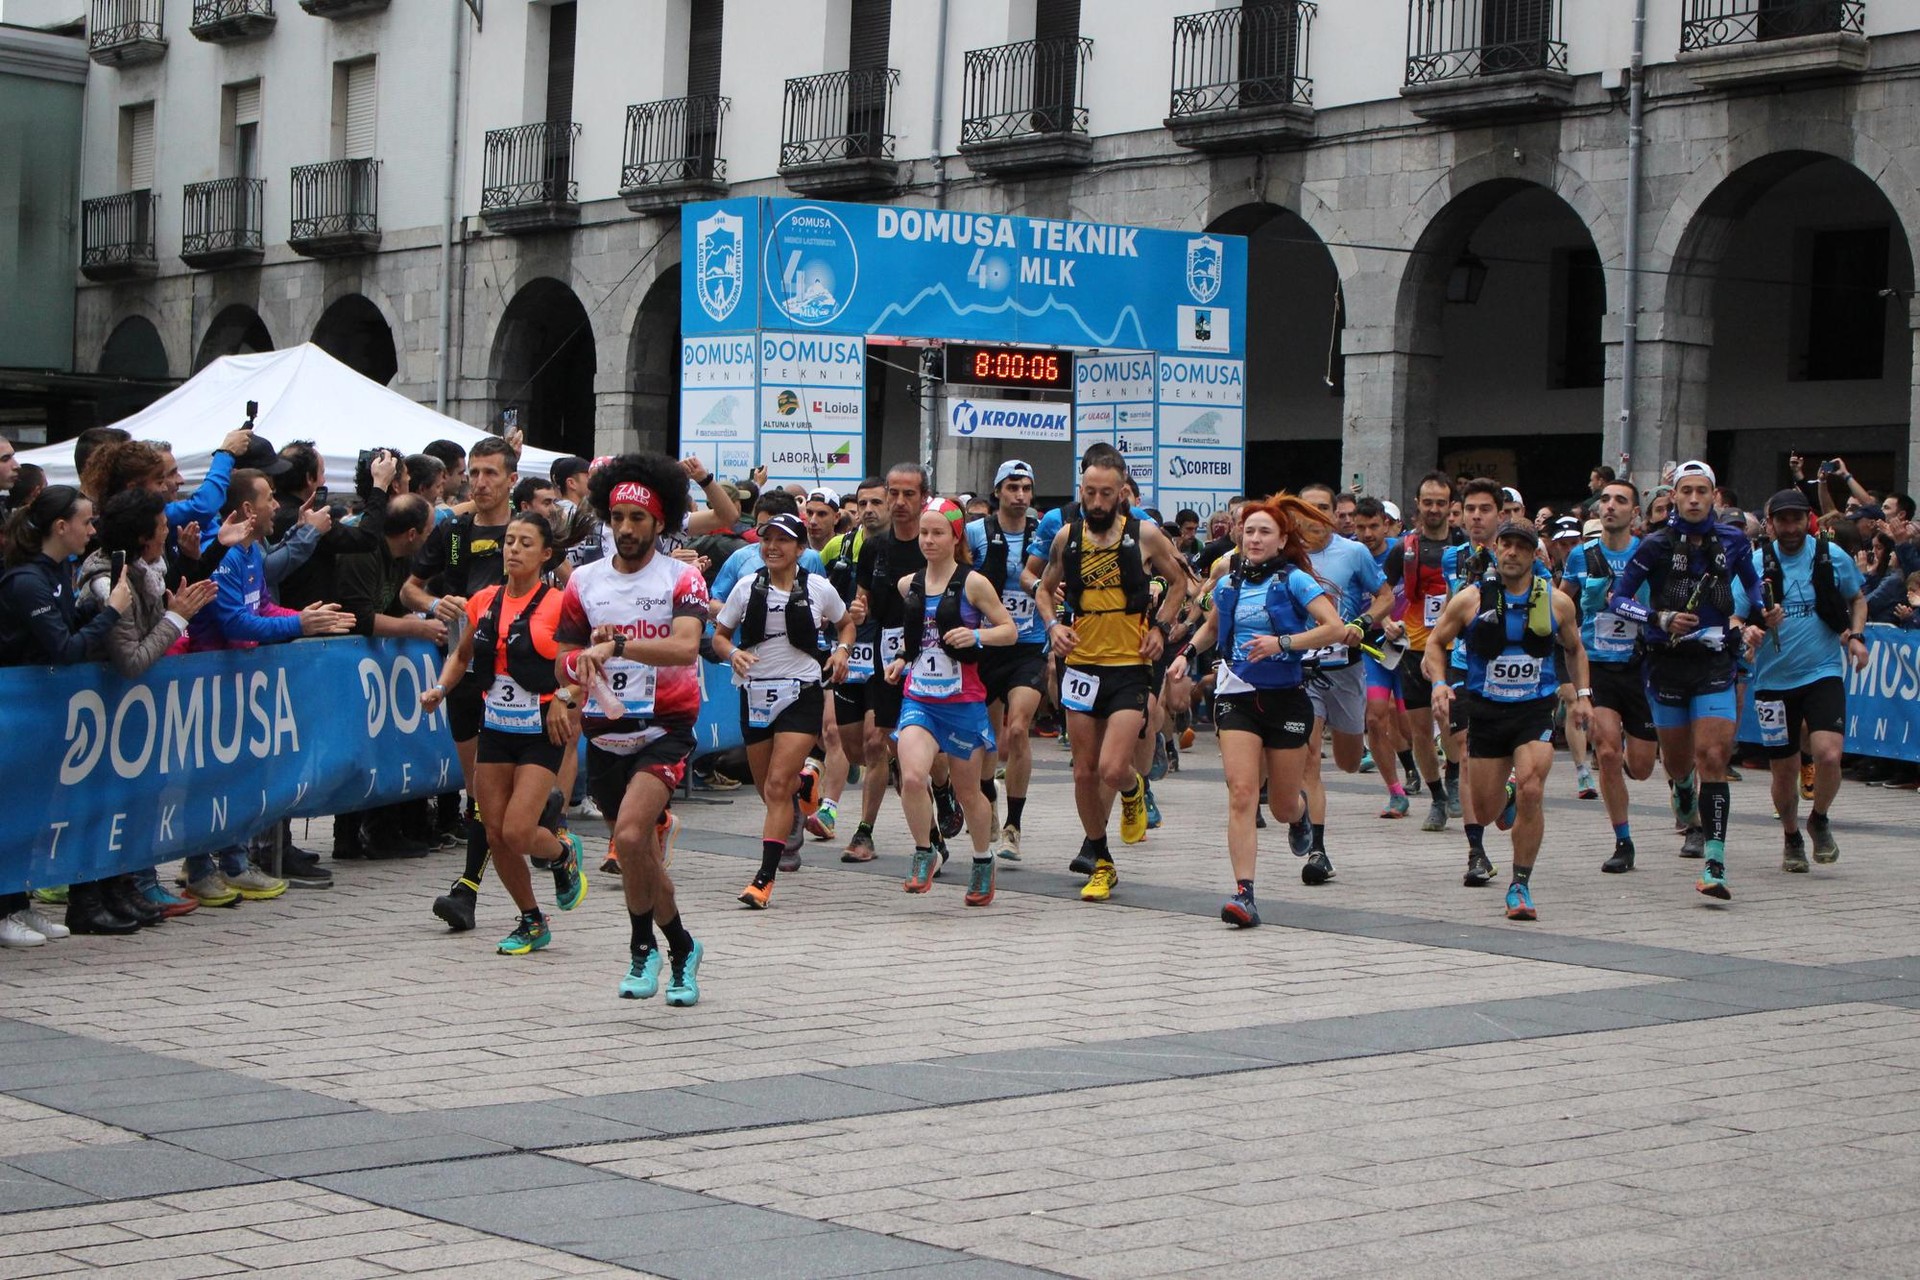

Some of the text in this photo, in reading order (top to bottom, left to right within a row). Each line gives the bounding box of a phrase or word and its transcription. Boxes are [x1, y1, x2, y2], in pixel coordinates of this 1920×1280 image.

[791, 216, 831, 229] DOMUSA
[877, 207, 1139, 257] DOMUSA TEKNIK
[1020, 255, 1076, 288] MLK
[684, 342, 754, 366] DOMUSA
[763, 339, 861, 365] DOMUSA
[763, 367, 861, 381] TEKNIK
[975, 352, 1058, 381] 8:00:06
[1078, 361, 1152, 385] DOMUSA
[1161, 362, 1242, 387] DOMUSA
[684, 371, 754, 381] TEKNIK
[1077, 386, 1153, 399] TEKNIK
[1160, 388, 1242, 401] TEKNIK
[824, 401, 858, 415] Loiola
[763, 420, 789, 429] ALTUNA
[980, 410, 1068, 430] KRONOAK
[1020, 430, 1064, 438] kronoak.com
[723, 459, 748, 467] KIROLAK
[772, 452, 825, 464] LABORAL
[802, 465, 826, 474] kutxa
[1187, 460, 1231, 475] CORTEBI
[616, 483, 651, 499] ZAID
[1672, 553, 1688, 564] ARCH
[1672, 562, 1688, 571] MAX
[1613, 620, 1626, 633] 2
[926, 656, 937, 672] 1
[1493, 662, 1534, 679] 509
[1840, 640, 1920, 702] MUS
[612, 672, 628, 691] 8
[1070, 678, 1092, 698] 10
[501, 684, 515, 703] 3
[765, 688, 779, 703] 5
[59, 666, 300, 786] DOMUSA
[49, 781, 309, 860] TEKNIK
[1711, 794, 1726, 840] Kalenji
